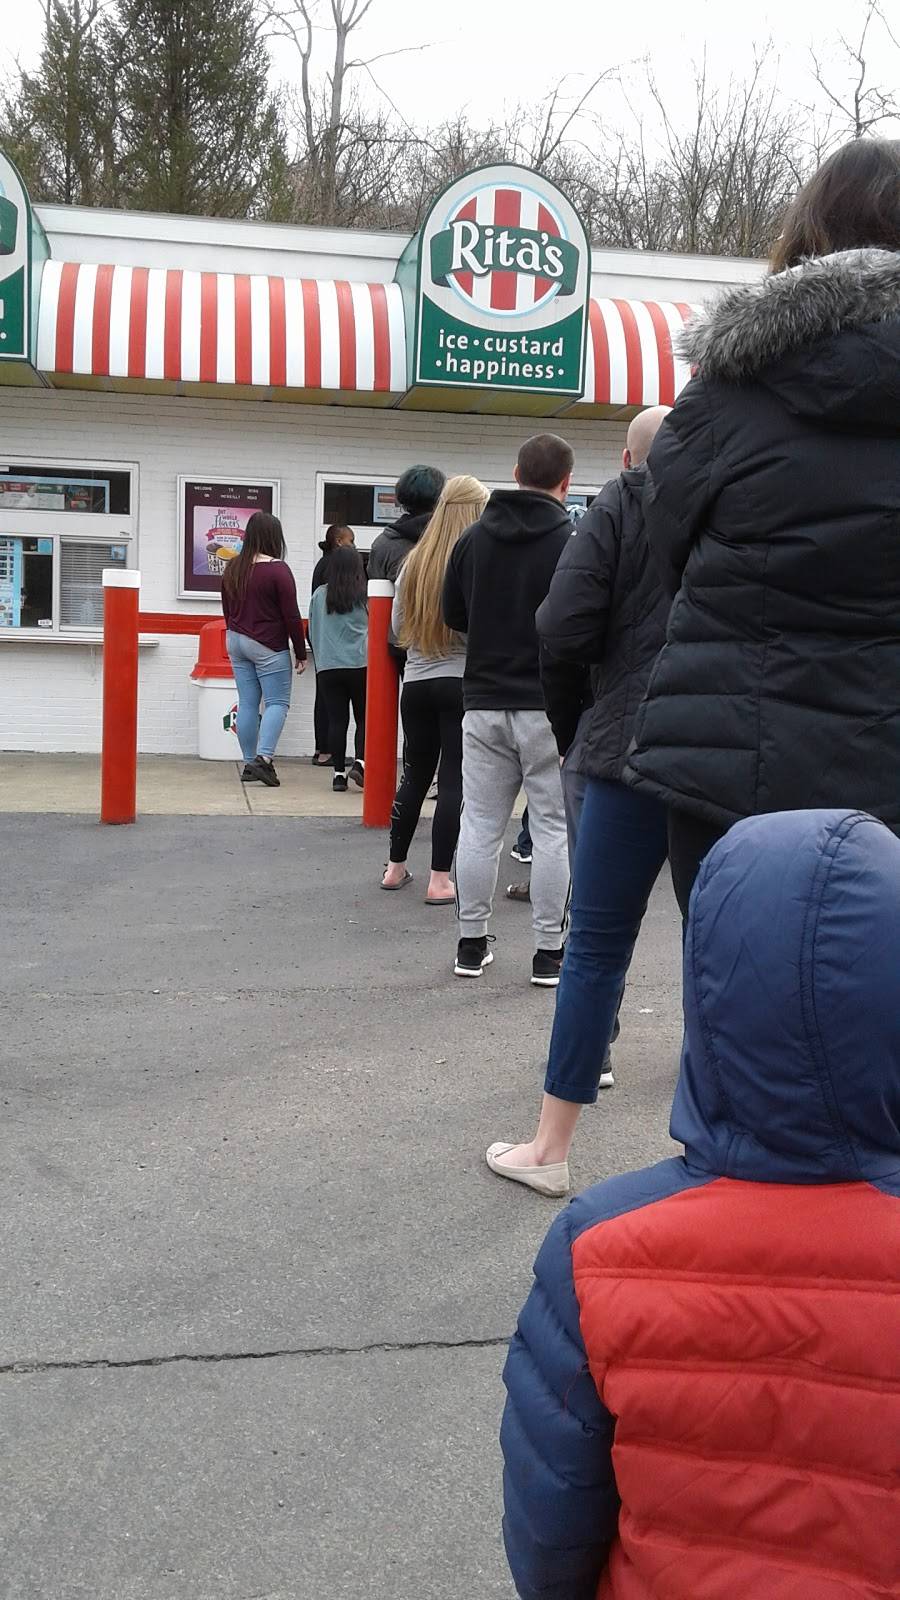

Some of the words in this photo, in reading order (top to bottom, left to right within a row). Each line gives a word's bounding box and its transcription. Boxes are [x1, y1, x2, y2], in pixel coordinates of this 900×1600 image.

[451, 220, 564, 277] Rita's
[439, 329, 469, 349] ice
[484, 336, 564, 357] custard
